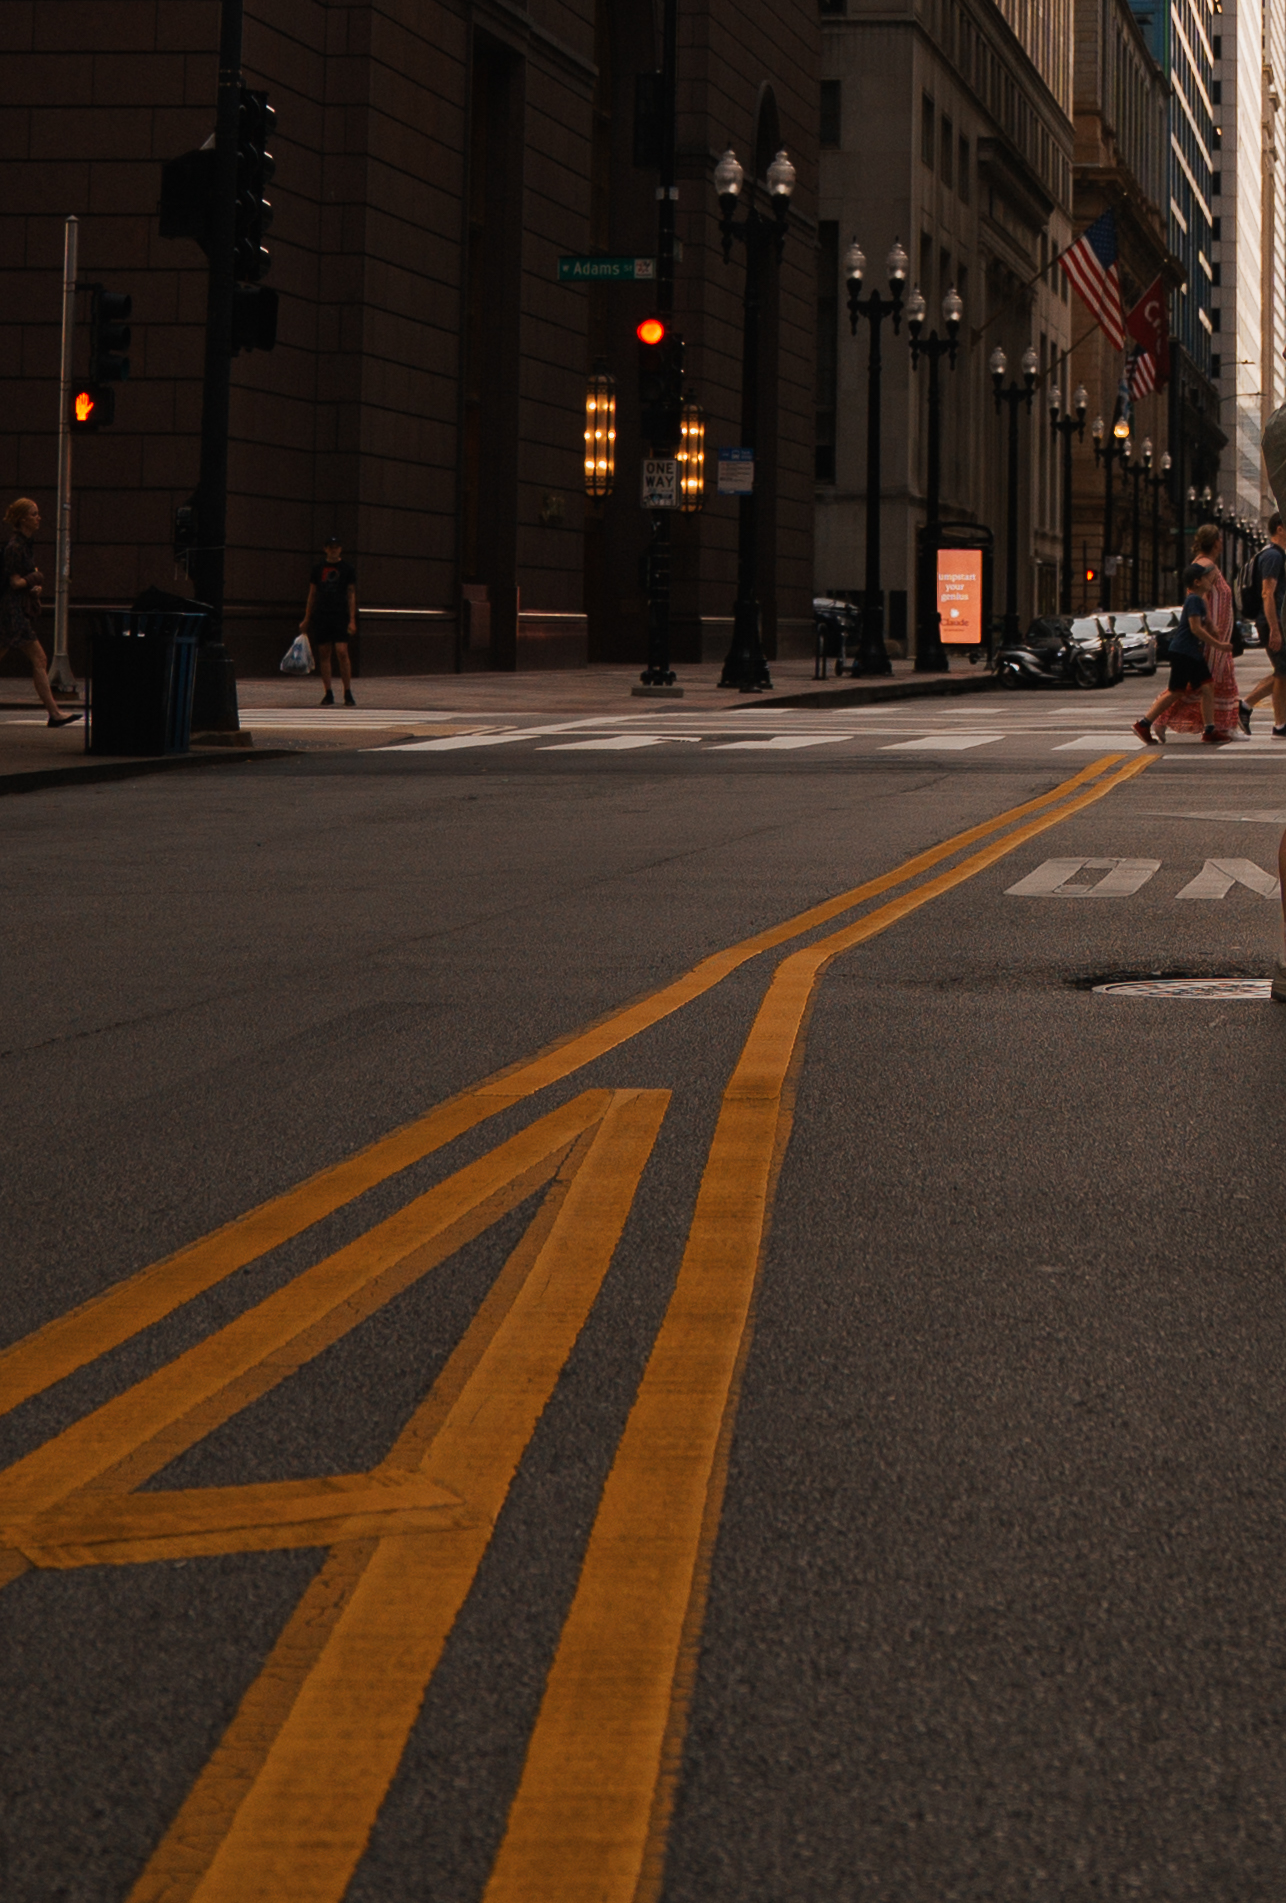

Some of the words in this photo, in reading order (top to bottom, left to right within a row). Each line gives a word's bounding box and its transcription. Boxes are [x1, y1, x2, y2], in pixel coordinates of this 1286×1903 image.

[573, 261, 620, 276] Adams
[646, 462, 673, 474] ONE
[646, 476, 674, 487] WAY
[938, 573, 976, 582] umpstart
[945, 584, 965, 592] your
[940, 593, 969, 602] genius
